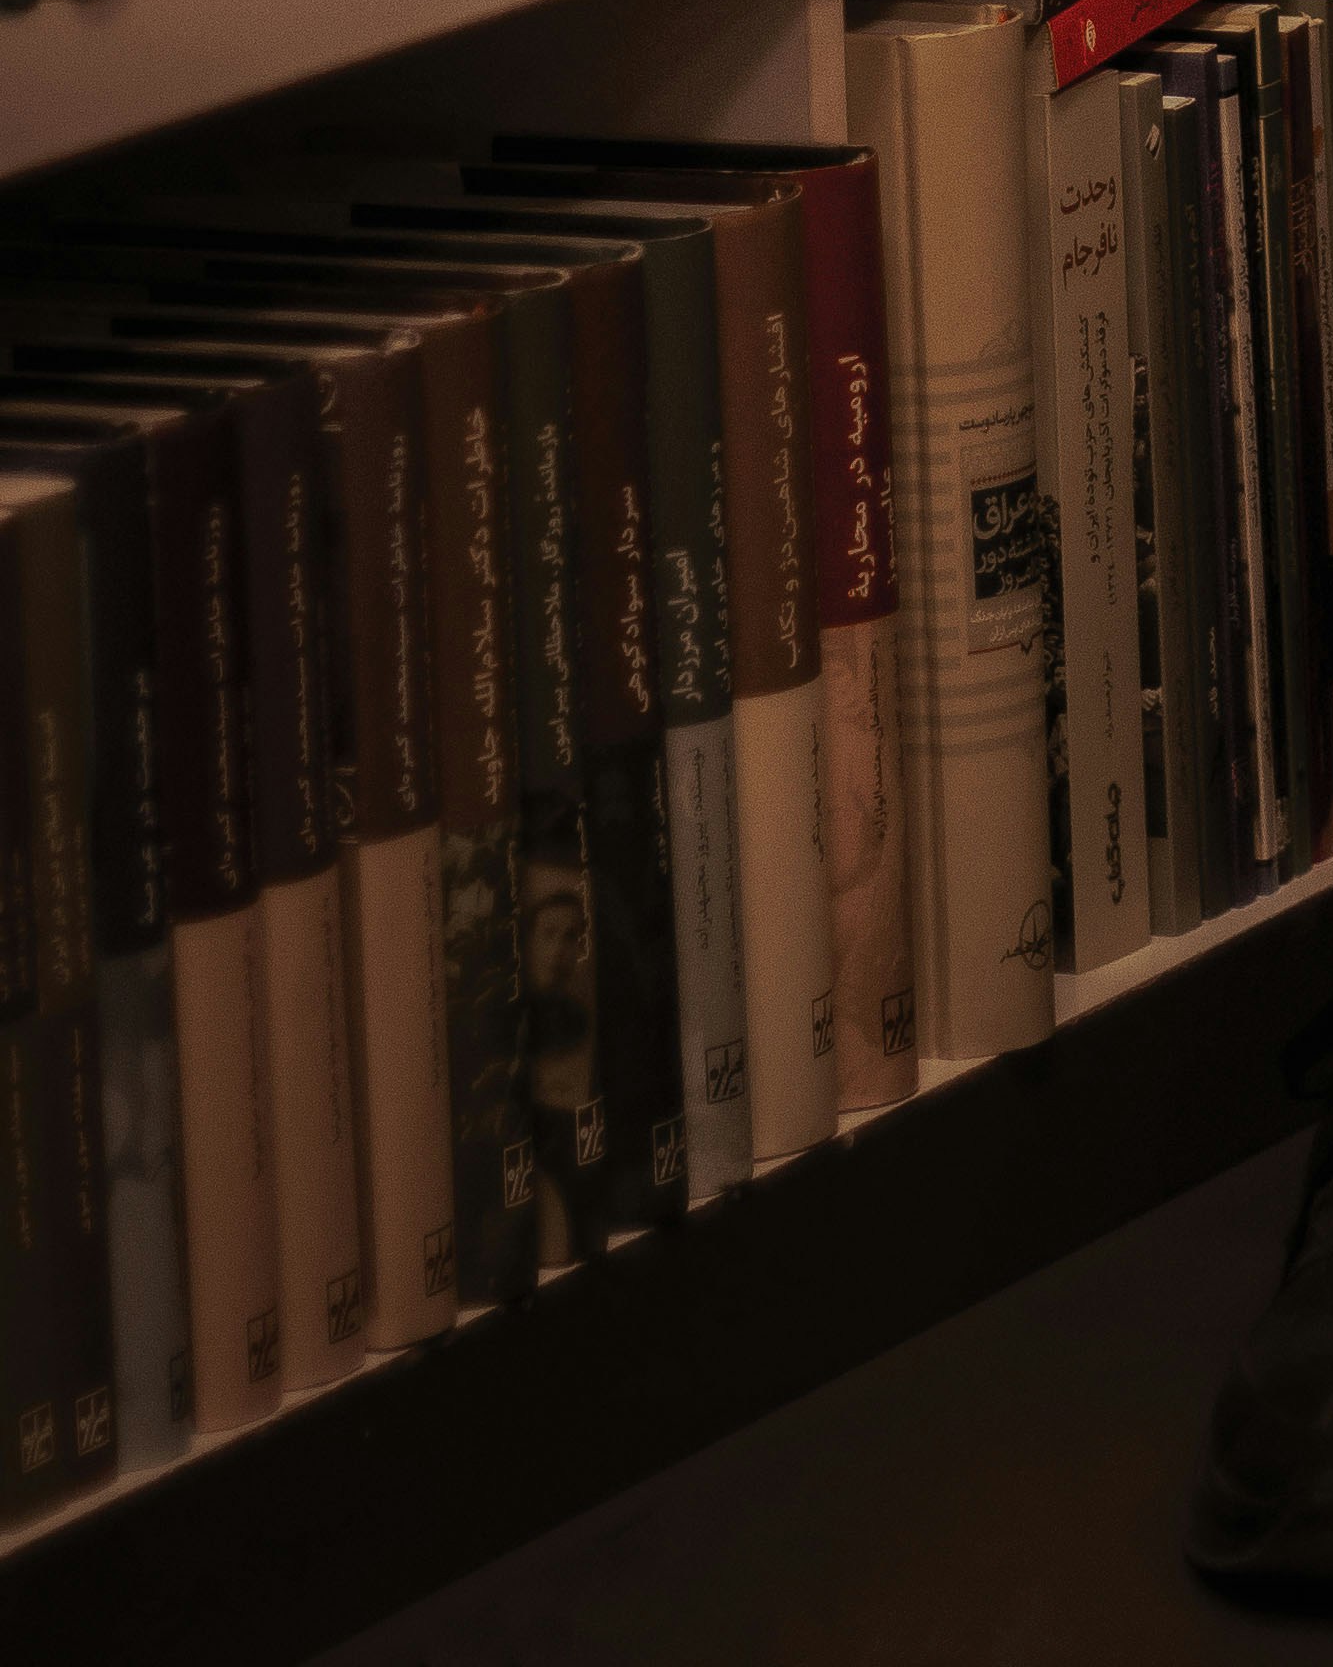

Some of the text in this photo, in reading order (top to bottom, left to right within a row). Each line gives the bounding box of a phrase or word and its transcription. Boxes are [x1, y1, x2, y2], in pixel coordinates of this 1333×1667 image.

[1059, 174, 1117, 215] وحدت
[464, 405, 494, 519] خاطرات
[837, 352, 873, 487] ارومیه در
[469, 525, 494, 585] دکتر
[617, 483, 641, 561] سردار
[664, 546, 703, 702] امیران مرزدار
